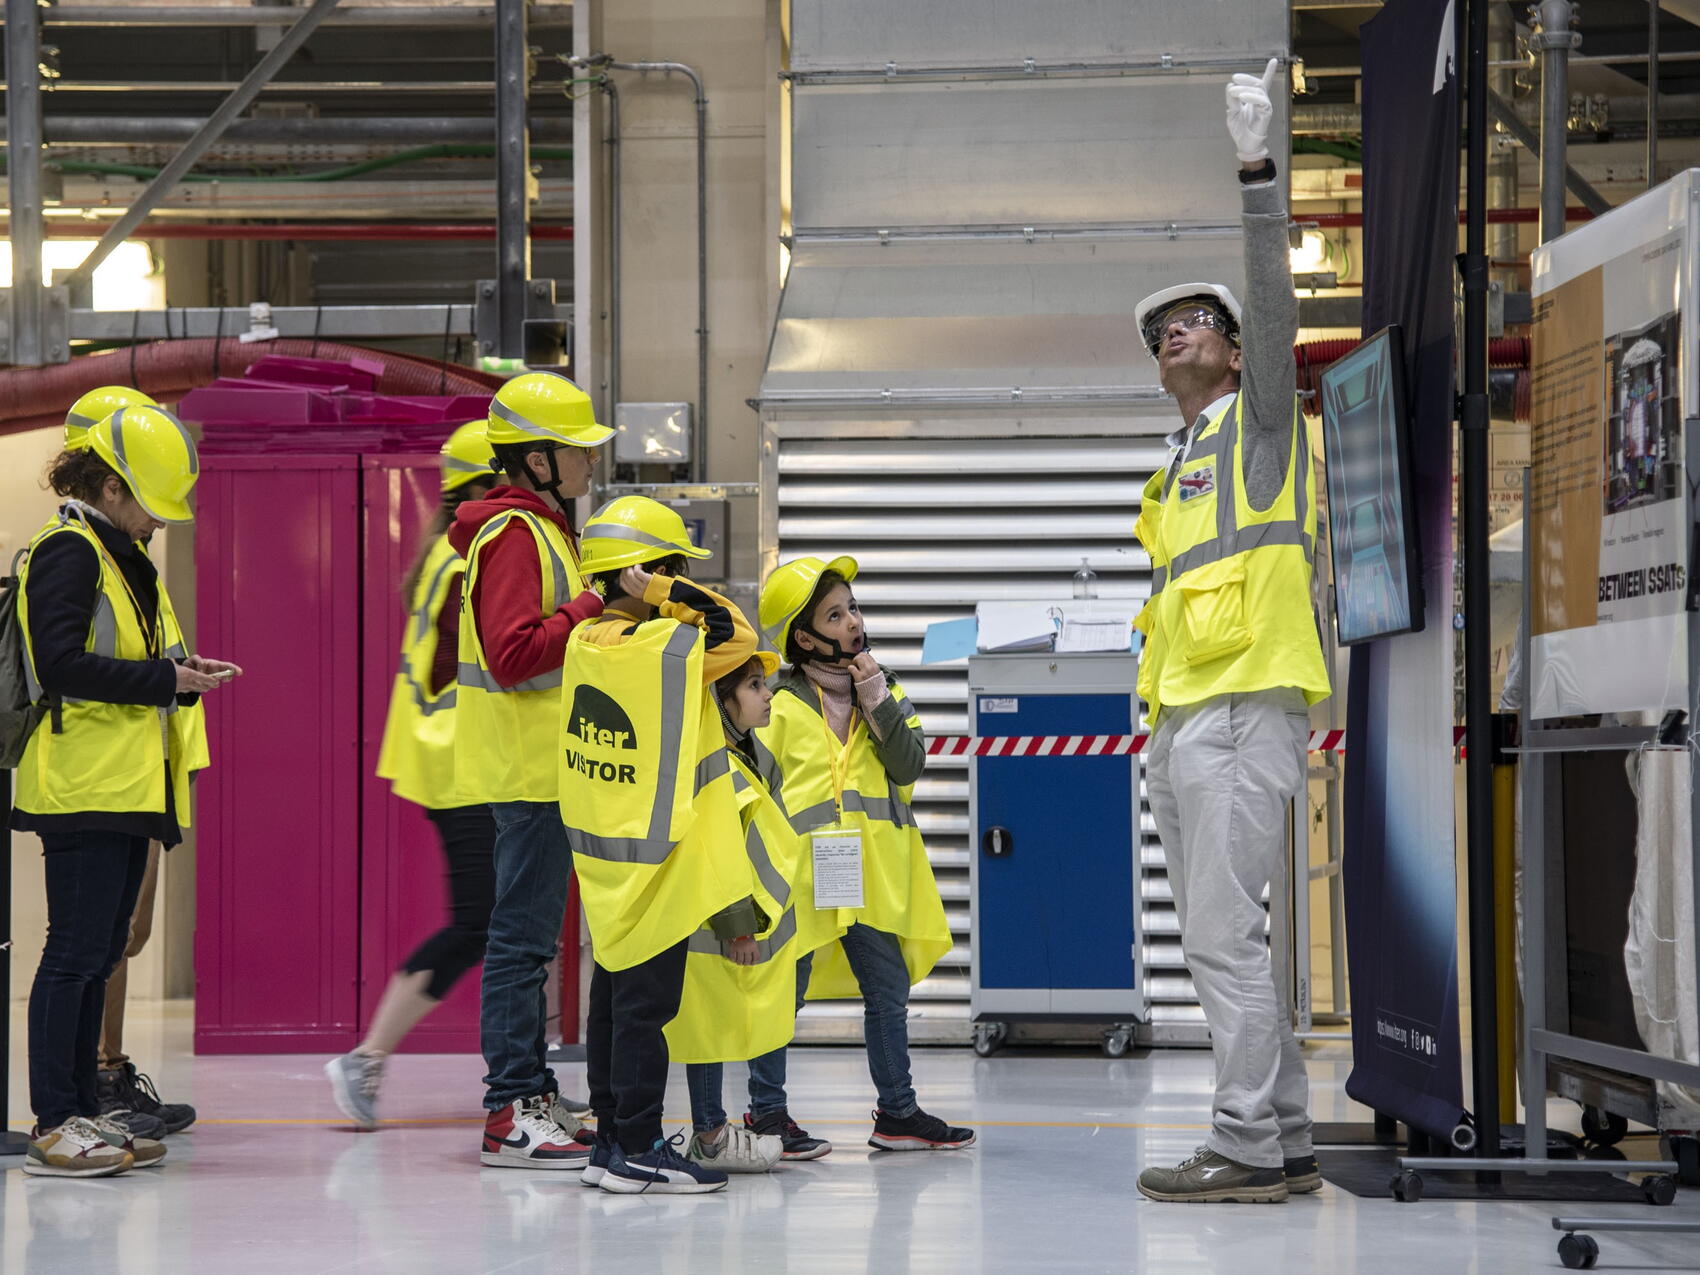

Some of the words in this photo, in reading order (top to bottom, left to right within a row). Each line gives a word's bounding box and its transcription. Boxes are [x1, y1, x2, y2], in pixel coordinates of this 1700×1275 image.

[1598, 568, 1646, 603] BETWEEN
[1648, 563, 1686, 594] SSATS
[580, 717, 629, 748] iter
[566, 749, 636, 784] VISTOR
